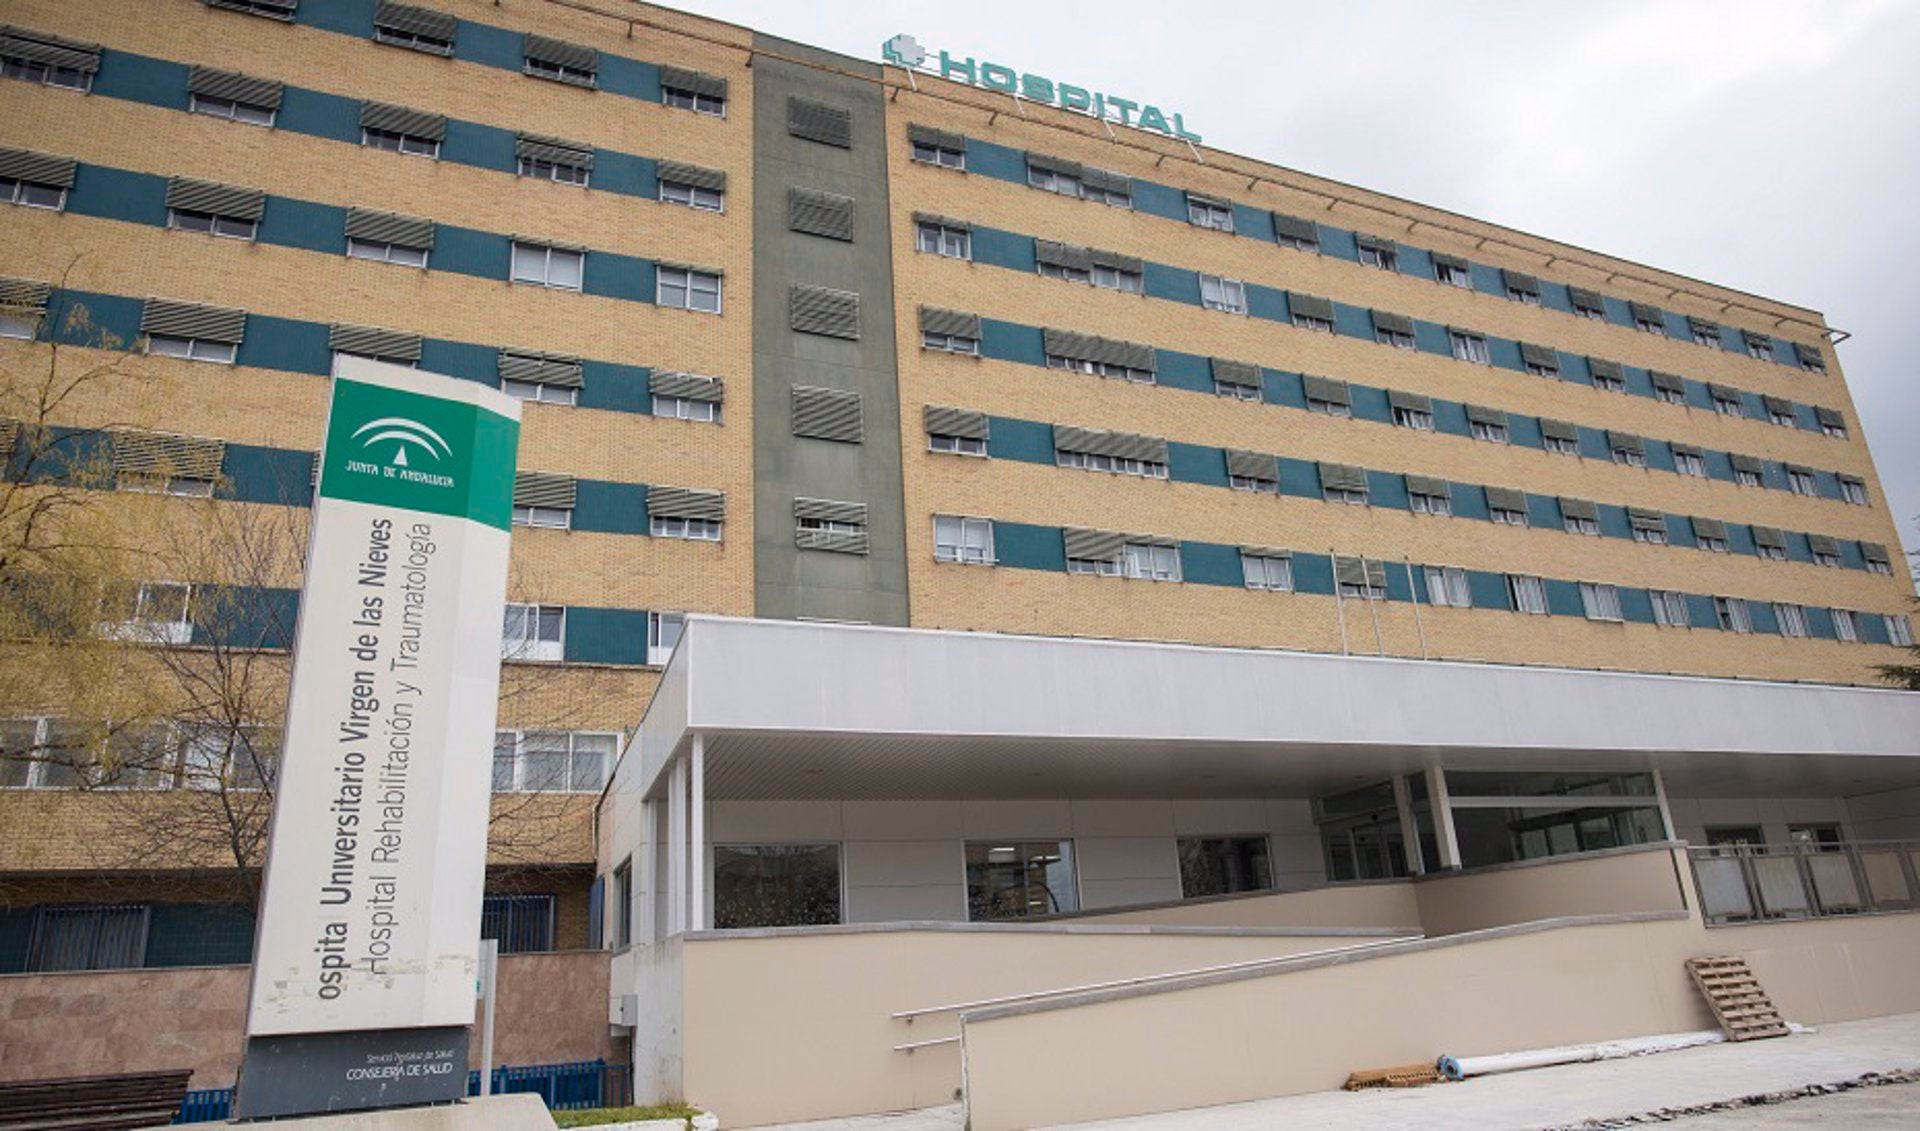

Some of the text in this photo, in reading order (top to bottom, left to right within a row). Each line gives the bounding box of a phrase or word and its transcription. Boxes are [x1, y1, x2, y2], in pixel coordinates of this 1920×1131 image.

[940, 50, 1201, 144] HOSPITAL
[344, 460, 379, 475] JUNTA
[383, 466, 396, 478] DE
[358, 518, 392, 587] Nieves
[353, 596, 383, 627] las
[349, 634, 379, 661] de
[339, 670, 380, 743] Virgen
[361, 523, 436, 975] Hospital Rehabilitación y Traumatología
[320, 752, 366, 905] Universitario
[406, 1064, 421, 1076] DE
[423, 1062, 453, 1075] SALUD
